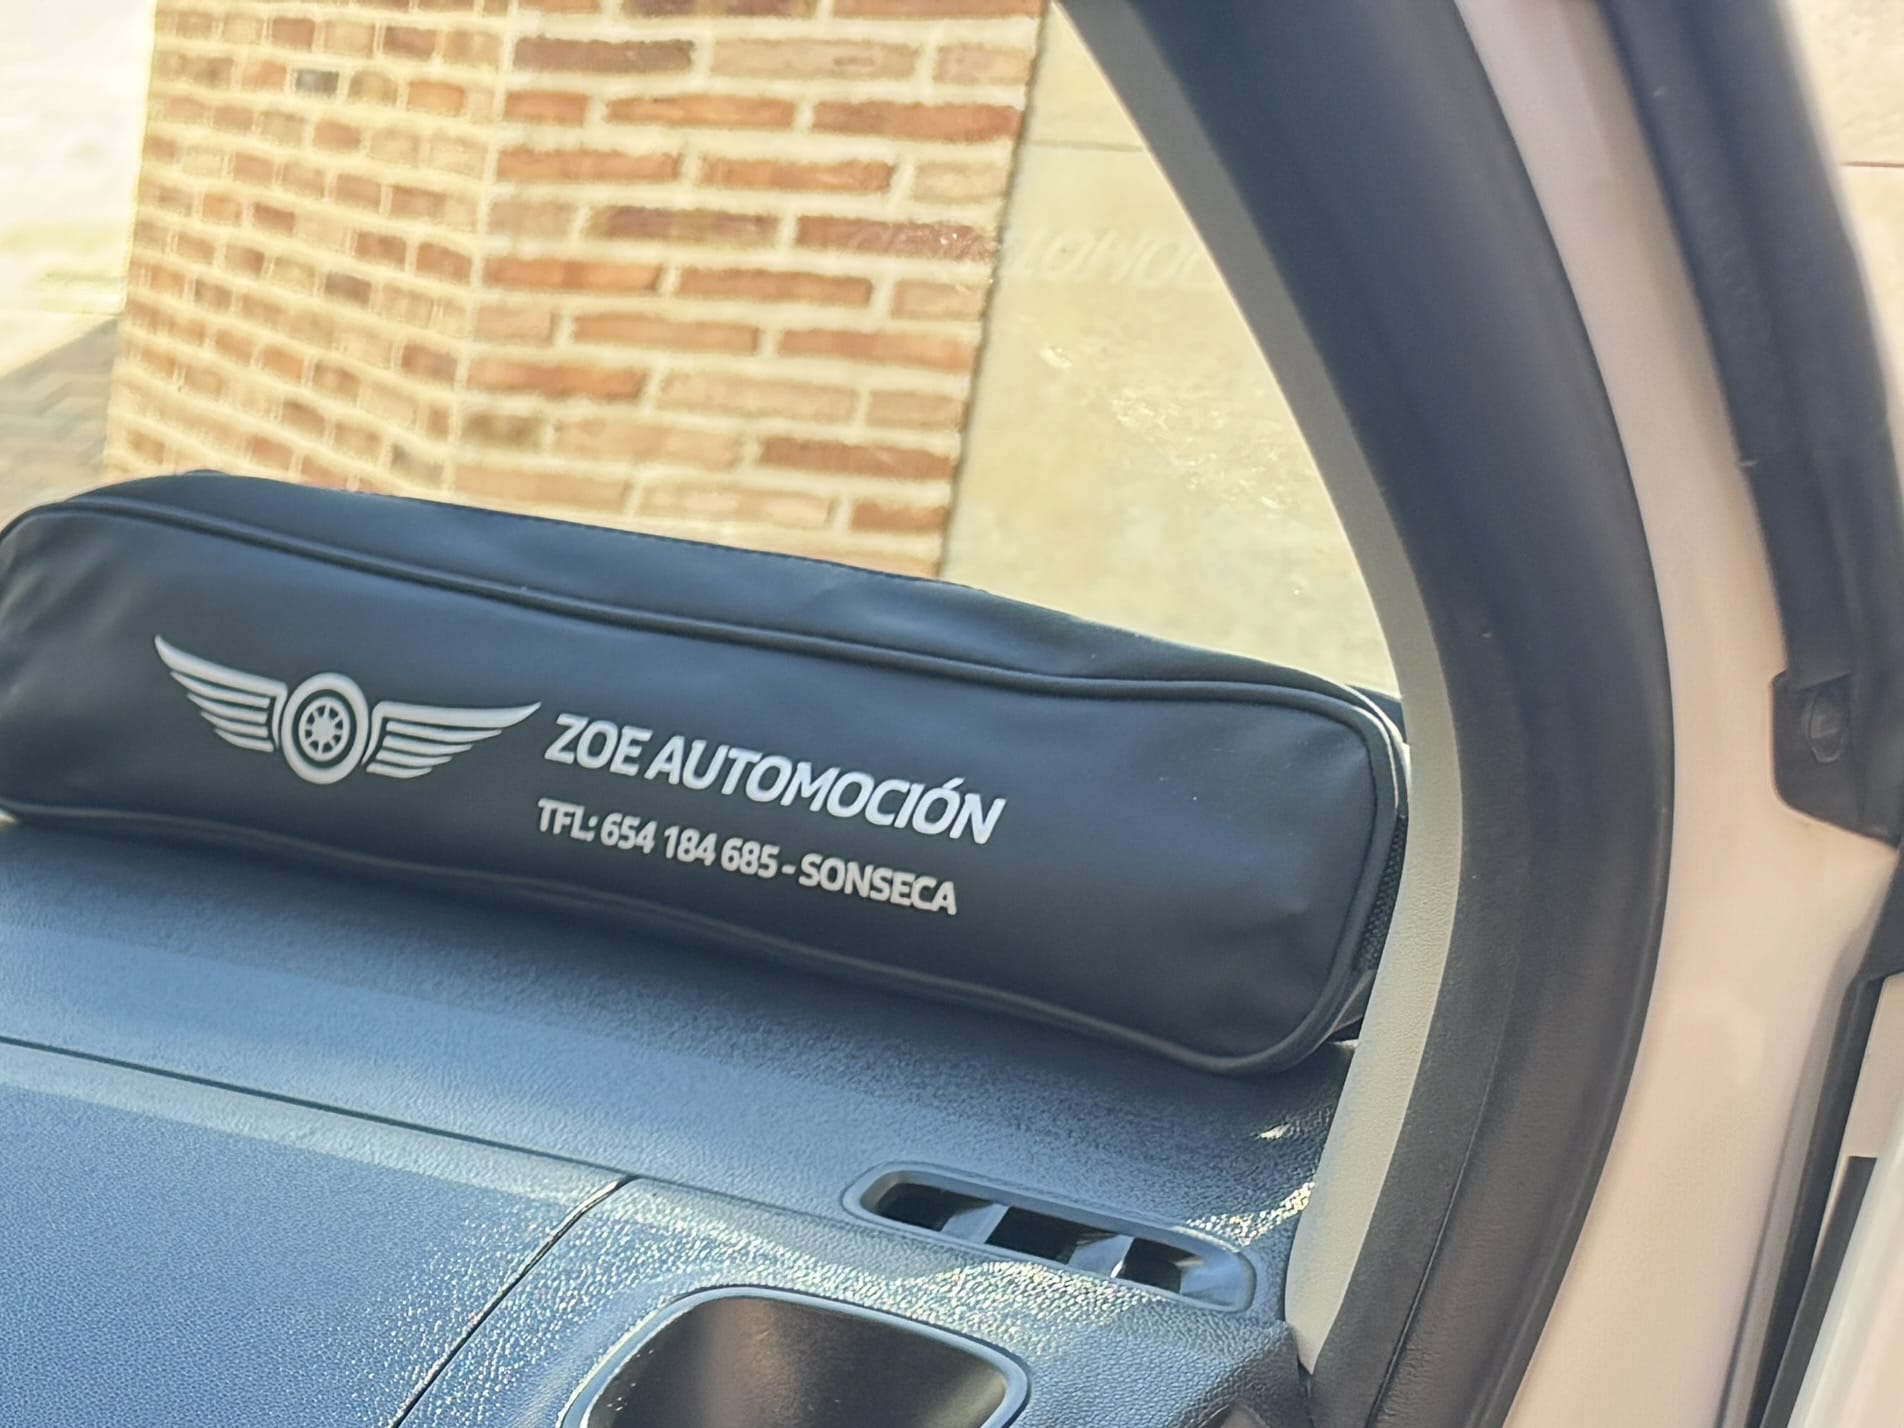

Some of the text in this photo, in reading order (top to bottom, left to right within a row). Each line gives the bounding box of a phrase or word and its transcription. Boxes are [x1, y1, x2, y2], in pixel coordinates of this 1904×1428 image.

[543, 712, 1008, 845] ZOE AUTOMOCIÓN
[537, 797, 599, 843] TFL:
[599, 812, 657, 854] 654
[663, 825, 717, 866] 184
[720, 837, 780, 879] 685
[798, 852, 958, 916] SONSECA
